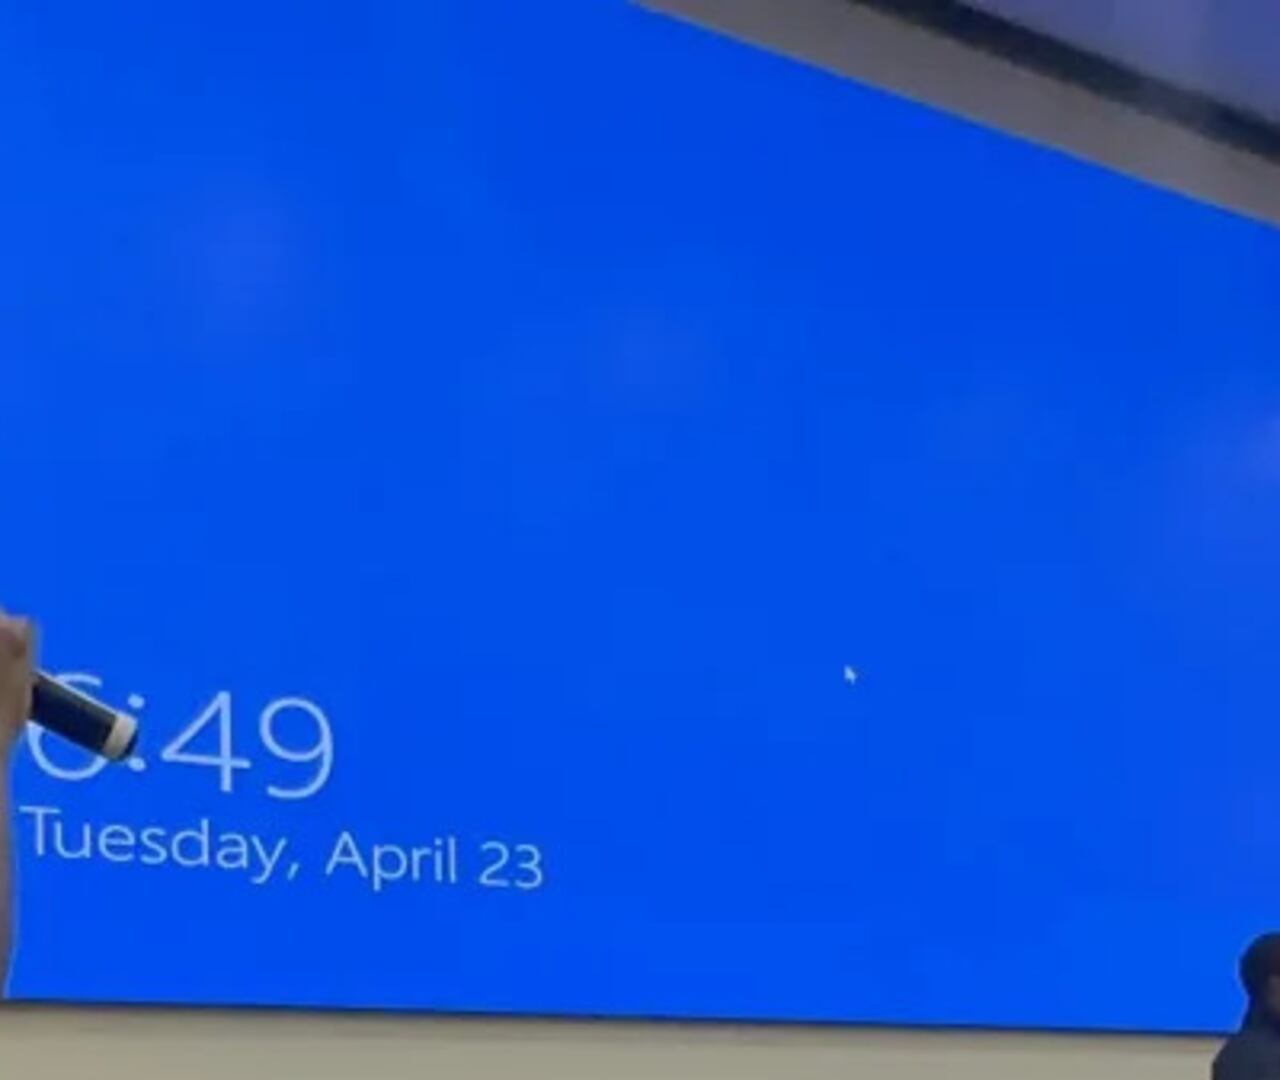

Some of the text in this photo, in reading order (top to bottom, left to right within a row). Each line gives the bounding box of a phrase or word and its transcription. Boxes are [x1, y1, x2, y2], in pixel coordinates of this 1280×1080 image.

[19, 805, 543, 890] Tuesday, April 23
